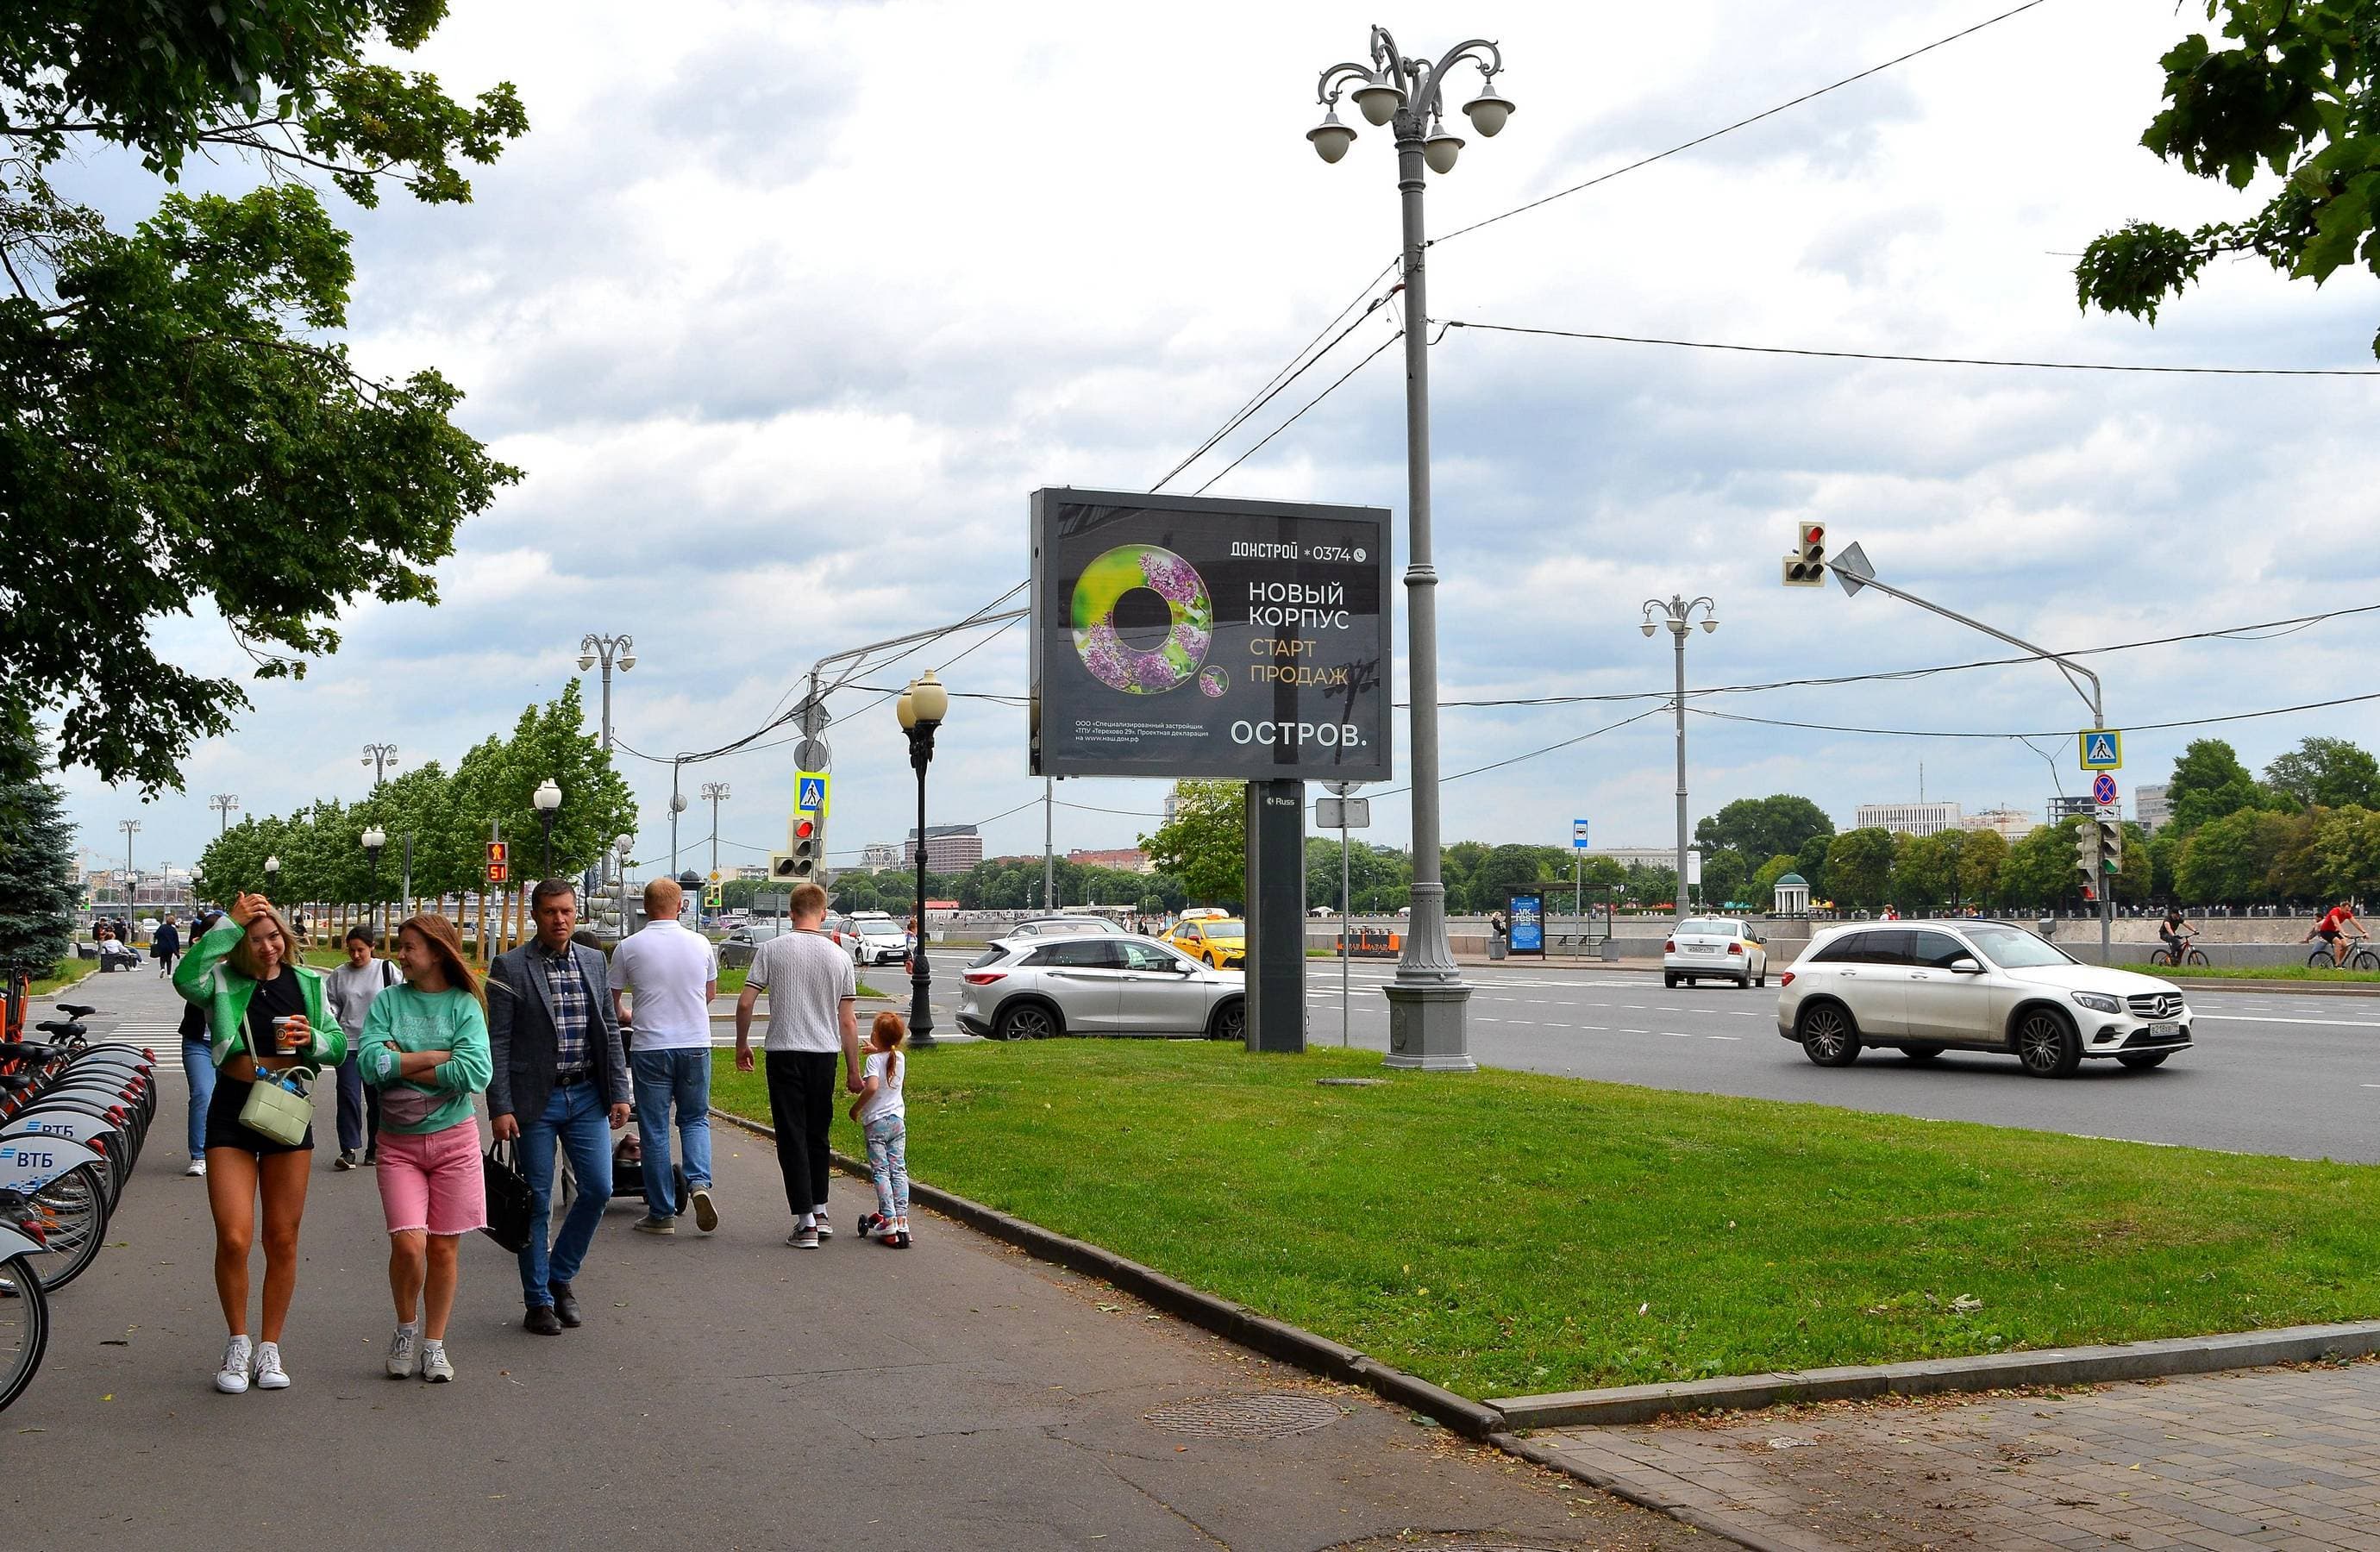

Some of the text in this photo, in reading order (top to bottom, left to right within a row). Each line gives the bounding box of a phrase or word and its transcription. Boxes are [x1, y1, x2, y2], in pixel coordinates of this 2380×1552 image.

[1231, 541, 1298, 560] ДОНСТРОЙ
[1250, 581, 1343, 605] НОВЫЙ
[1250, 605, 1350, 629] КОРПУС
[1250, 638, 1317, 658] СТАРТ
[1250, 665, 1349, 687] ПРОДАЖ
[1231, 720, 1367, 747] ОСТРОВ.
[490, 867, 504, 879] 51
[1516, 913, 1537, 922] fest
[17, 1152, 53, 1168] ВТБ
